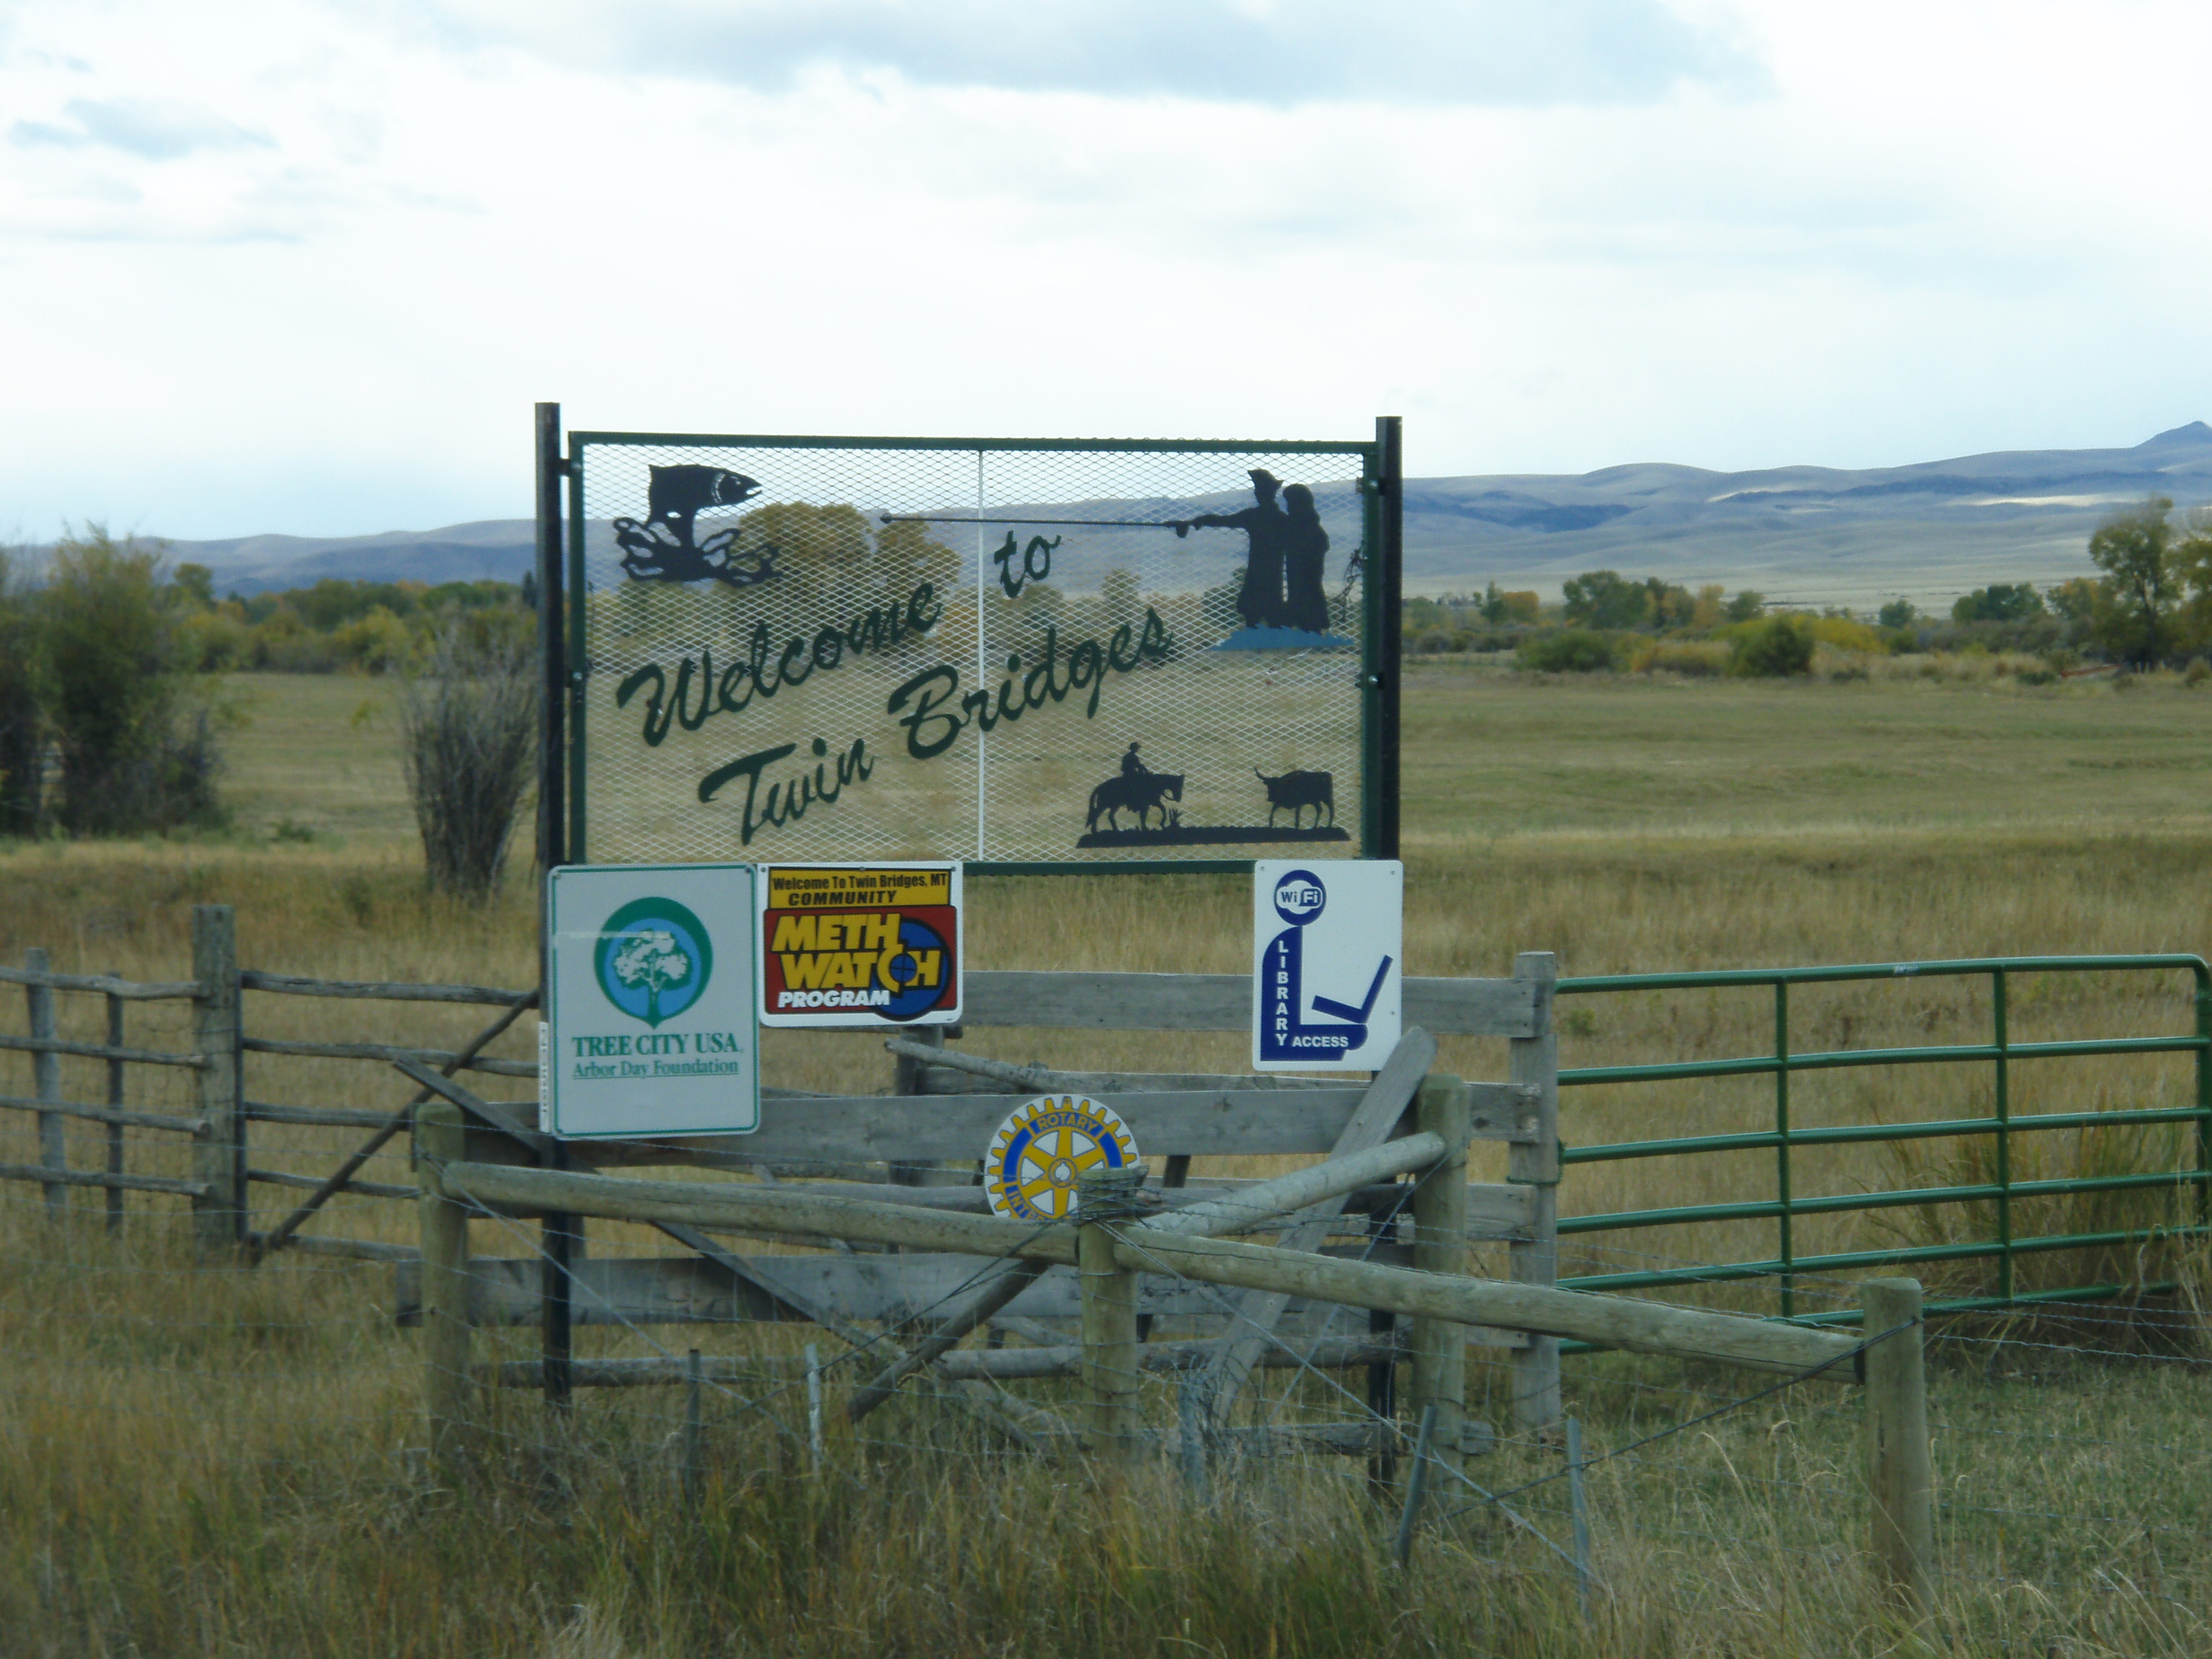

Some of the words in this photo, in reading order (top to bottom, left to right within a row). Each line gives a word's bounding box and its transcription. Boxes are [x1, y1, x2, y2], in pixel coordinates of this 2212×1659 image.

[616, 582, 943, 747] Welcome
[994, 529, 1061, 598] to
[697, 737, 875, 846] Twin
[887, 606, 1175, 760] Bridges
[773, 876, 829, 890] Welcome
[832, 876, 846, 889] To
[850, 875, 876, 888] Twin
[880, 874, 927, 889] Bridges,
[930, 873, 947, 886] MT
[788, 890, 897, 906] COMMUNITY
[771, 913, 901, 951] METH
[780, 944, 940, 993] WATCH
[778, 990, 890, 1008] PROGRAM
[1276, 940, 1289, 1046] LIBRARY
[572, 1035, 631, 1057] TREE
[635, 1034, 688, 1055] CITY
[1292, 1036, 1349, 1048] ACCESS
[575, 1061, 616, 1078] Arbor
[621, 1061, 647, 1079] Day
[653, 1058, 739, 1075] Foundation
[1035, 1113, 1099, 1132] ROTARY
